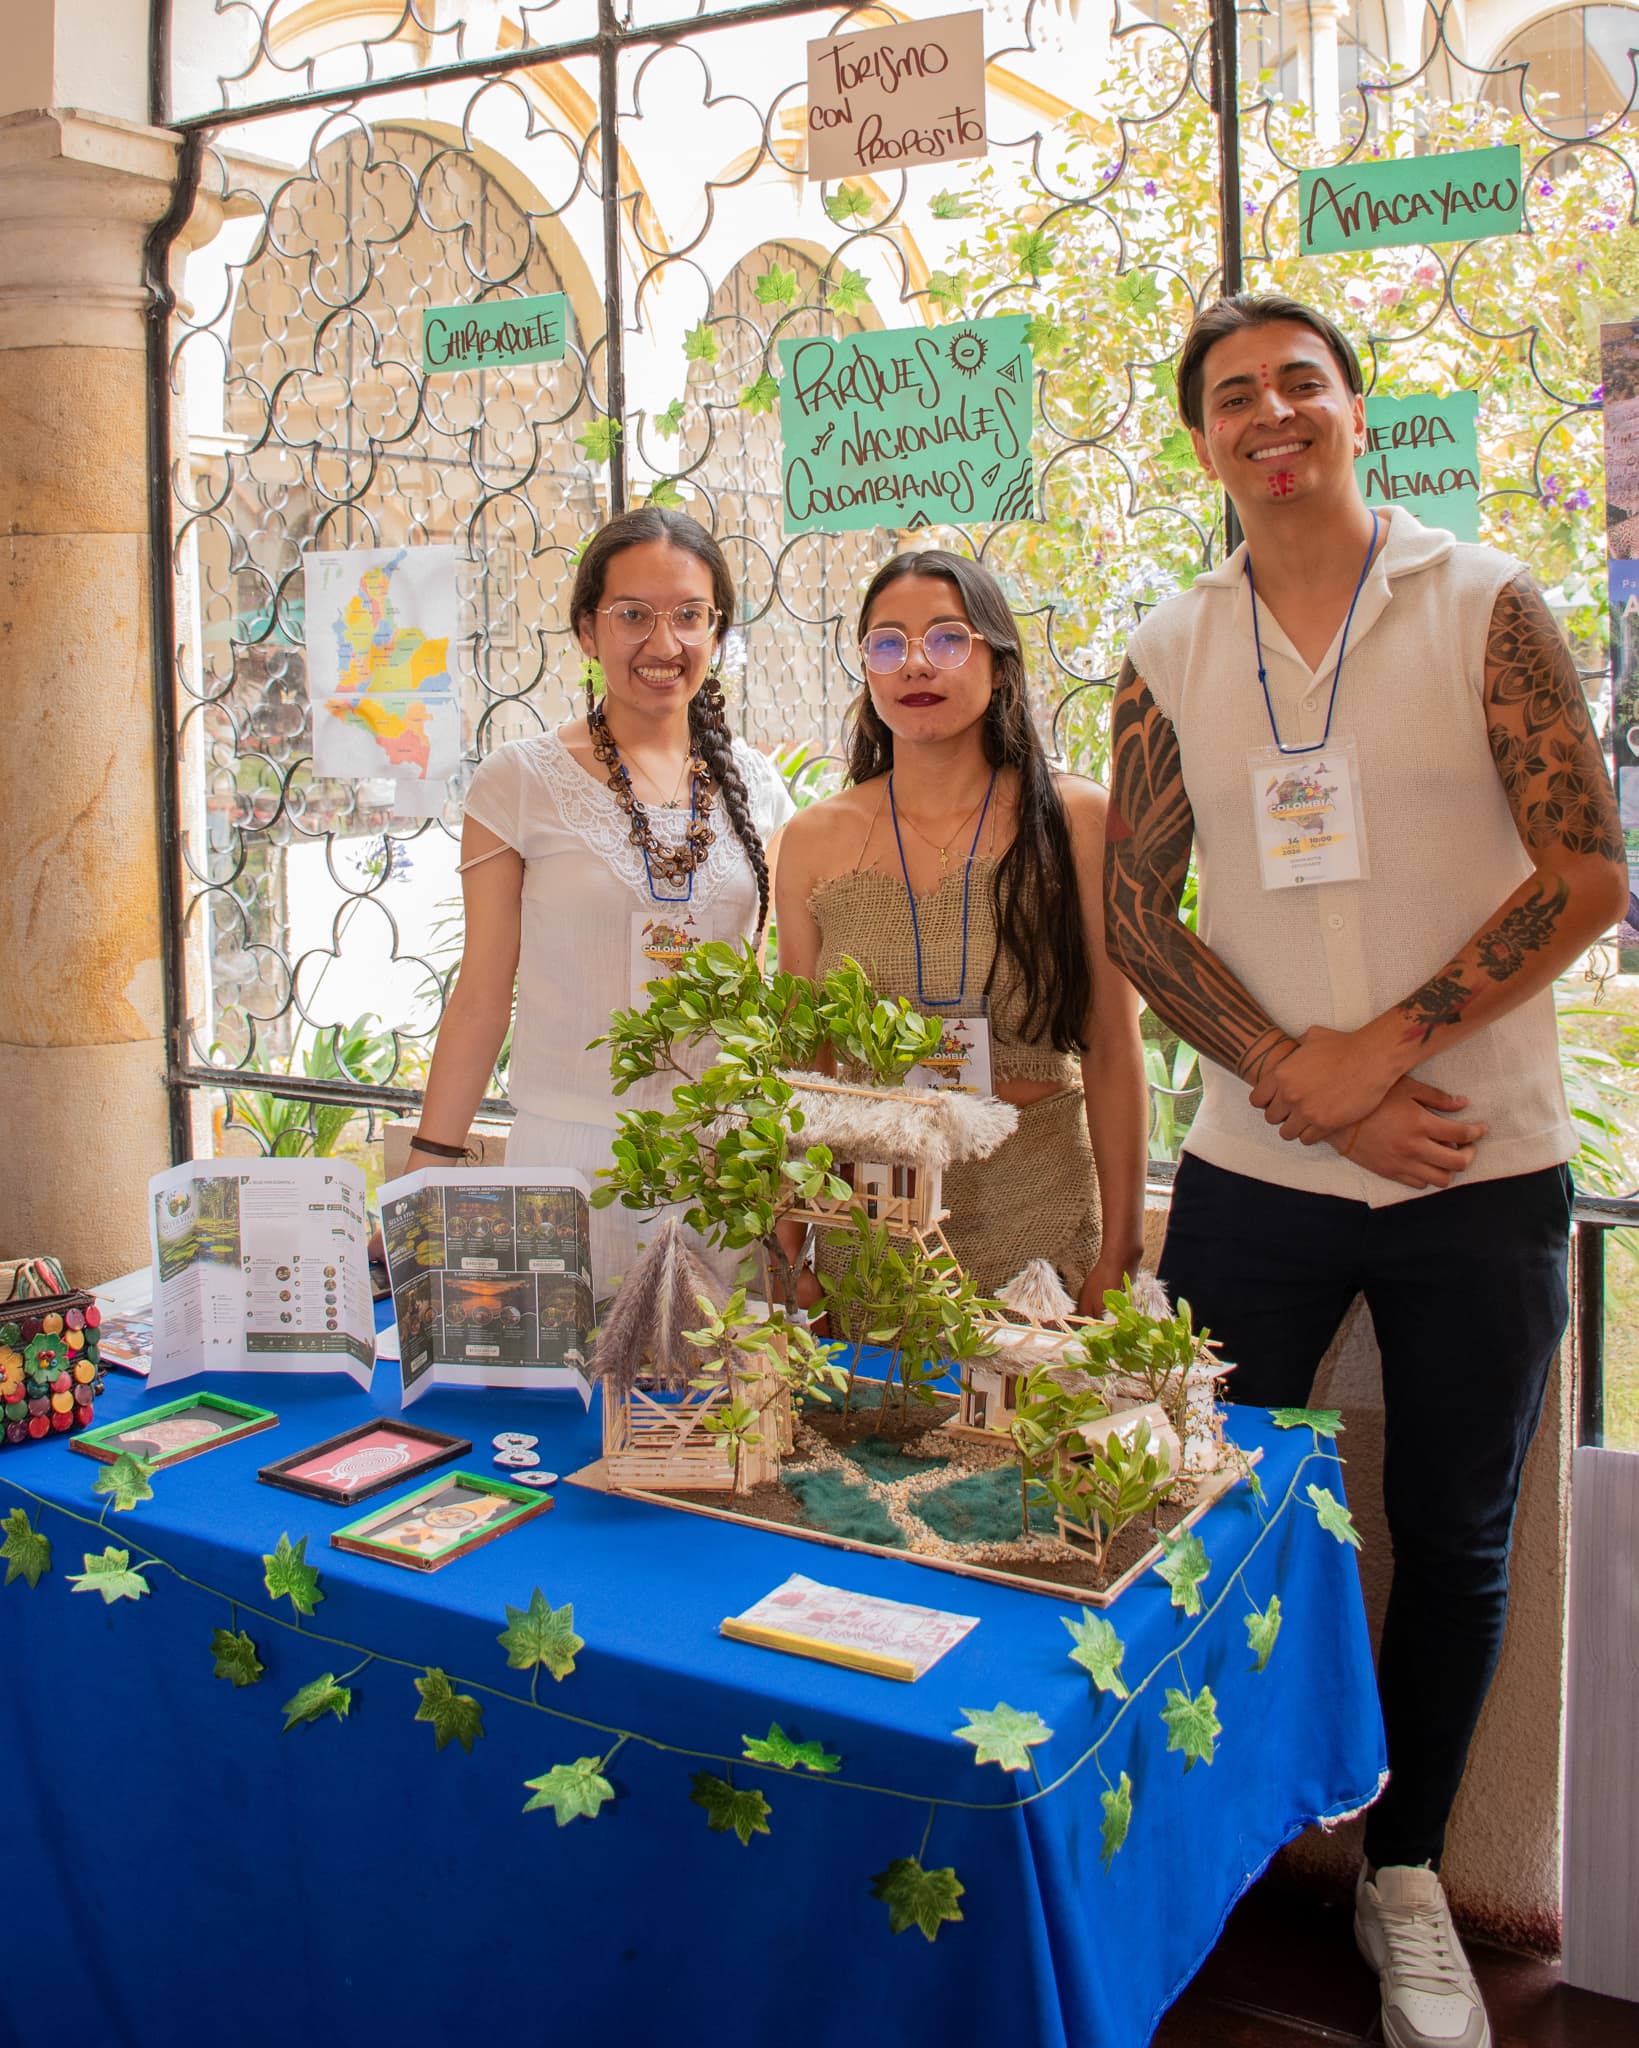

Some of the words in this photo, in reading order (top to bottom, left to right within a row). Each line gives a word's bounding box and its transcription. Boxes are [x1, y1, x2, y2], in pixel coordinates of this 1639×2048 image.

[818, 42, 949, 94] TURISMO
[809, 97, 852, 130] CON
[792, 337, 941, 417] PARQUES
[841, 386, 1019, 467] NACIONALES
[1366, 415, 1456, 452] IERRA
[786, 456, 975, 521] COLOMBIANOS
[1366, 454, 1479, 500] NEVADA
[1269, 799, 1333, 812] COLOMBIA
